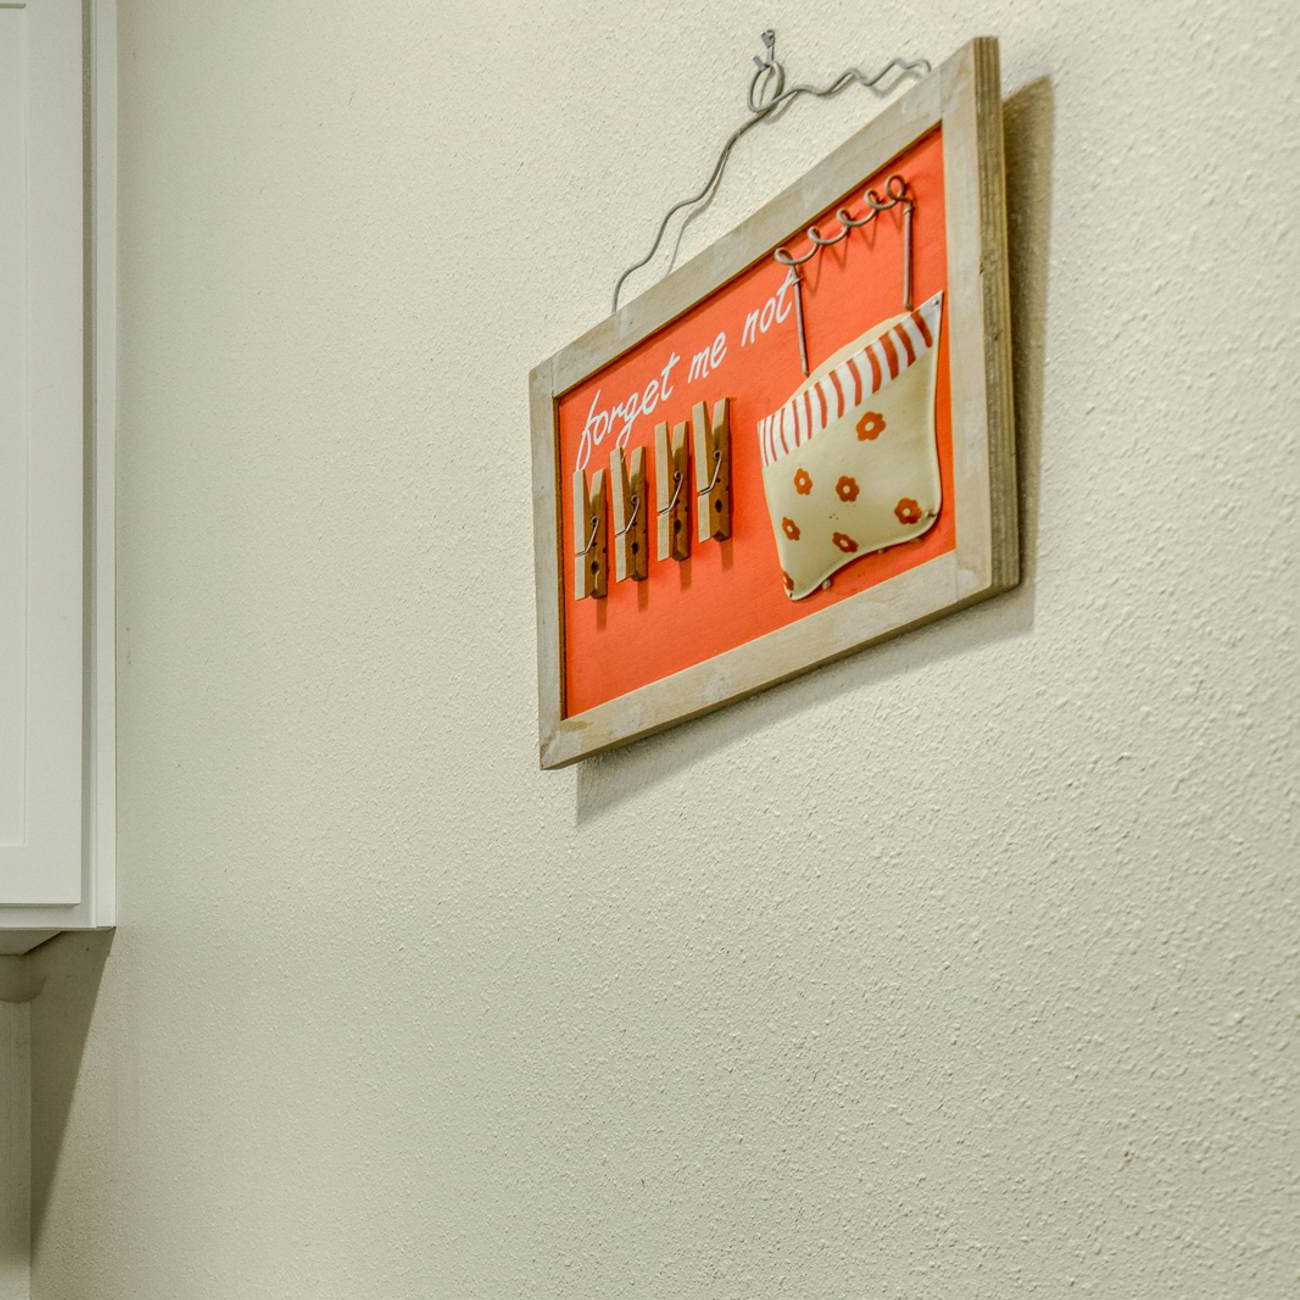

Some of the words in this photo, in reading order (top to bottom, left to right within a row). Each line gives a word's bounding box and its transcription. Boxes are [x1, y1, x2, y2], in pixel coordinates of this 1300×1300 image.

[576, 352, 680, 472] forget
[688, 331, 727, 384] me
[741, 268, 796, 347] not
